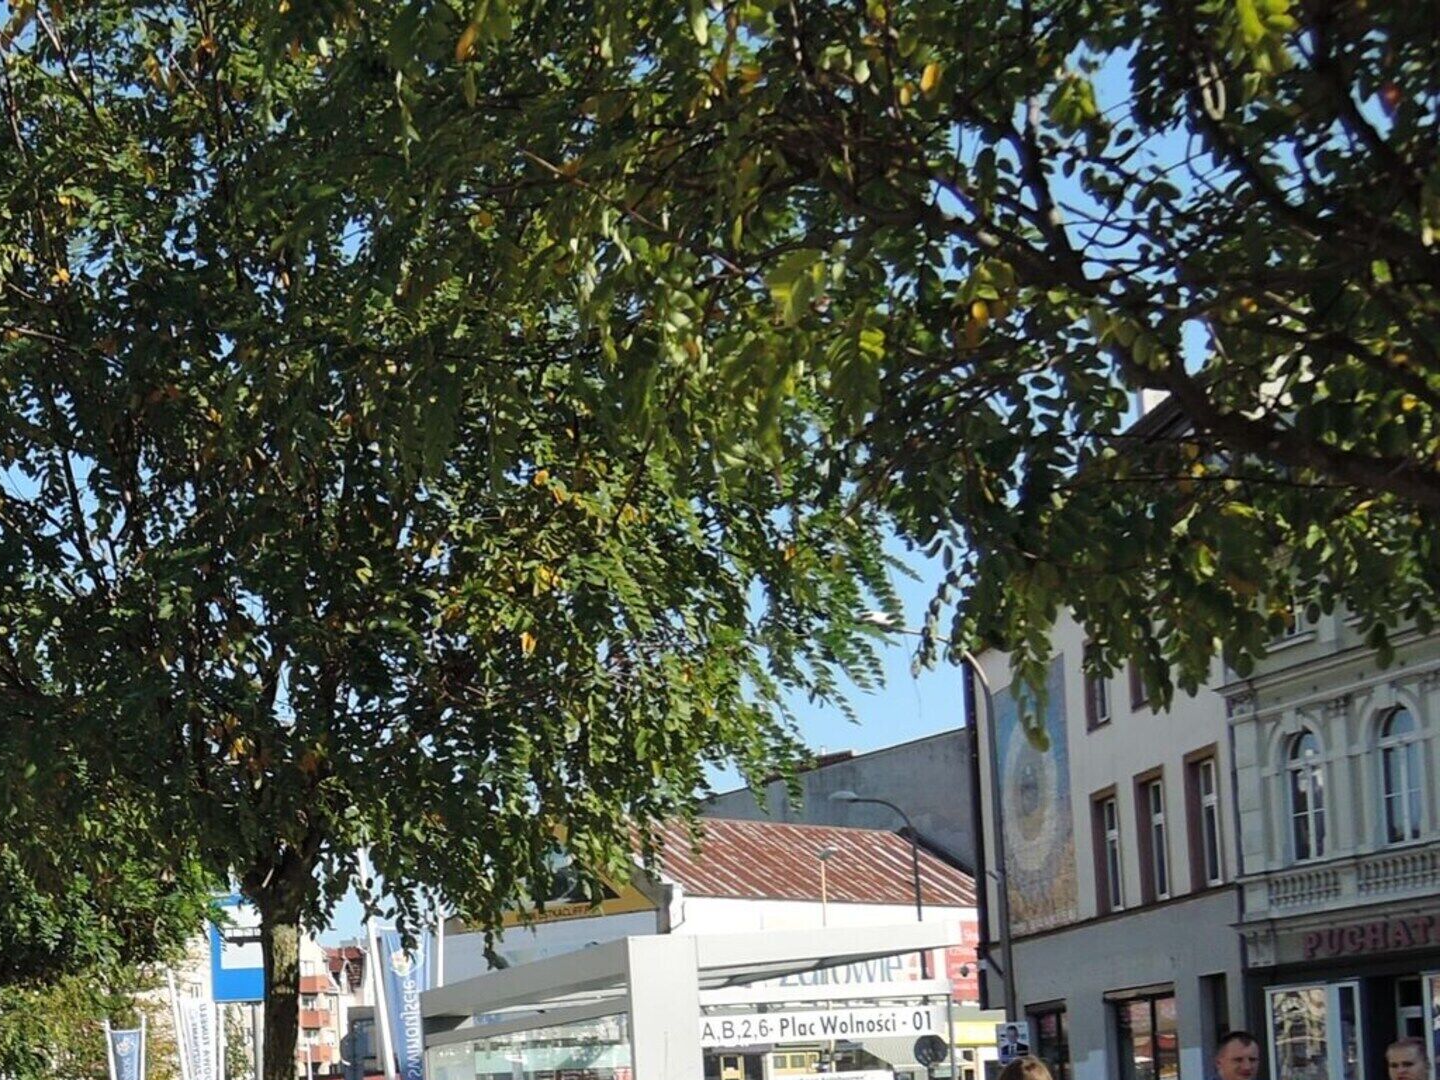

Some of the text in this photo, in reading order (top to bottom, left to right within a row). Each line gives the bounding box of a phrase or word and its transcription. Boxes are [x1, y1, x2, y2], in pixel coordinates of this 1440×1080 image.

[1303, 915, 1440, 959] PUCHAT
[779, 1016, 816, 1037] Plac
[820, 1012, 897, 1035] Wolności
[912, 1010, 932, 1031] 01
